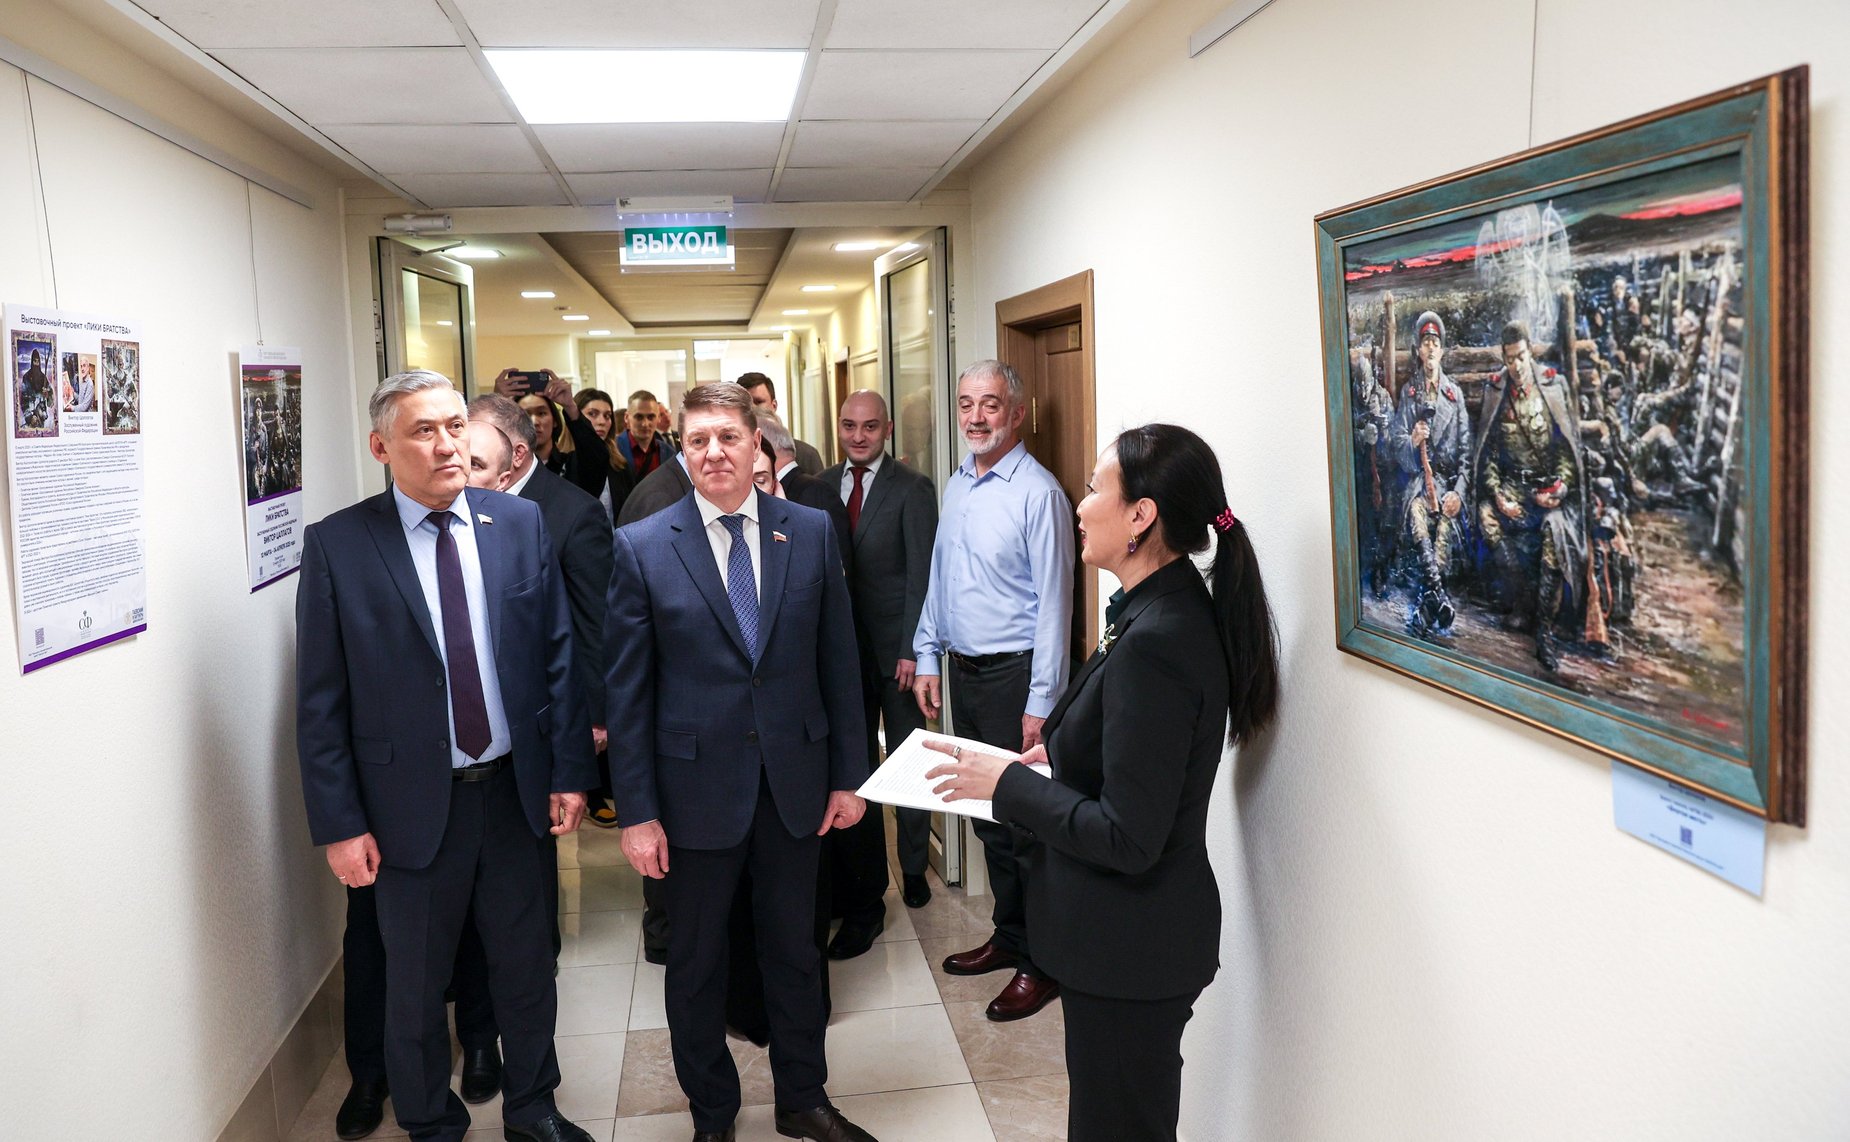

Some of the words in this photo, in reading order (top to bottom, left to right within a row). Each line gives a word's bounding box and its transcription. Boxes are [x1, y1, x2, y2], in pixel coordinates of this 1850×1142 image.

[632, 231, 719, 255] ВЫХОД
[21, 314, 61, 327] Выставочный
[62, 321, 83, 330] проект
[84, 322, 102, 331] «ЛИКИ
[103, 324, 131, 334] БРАТСТВА»
